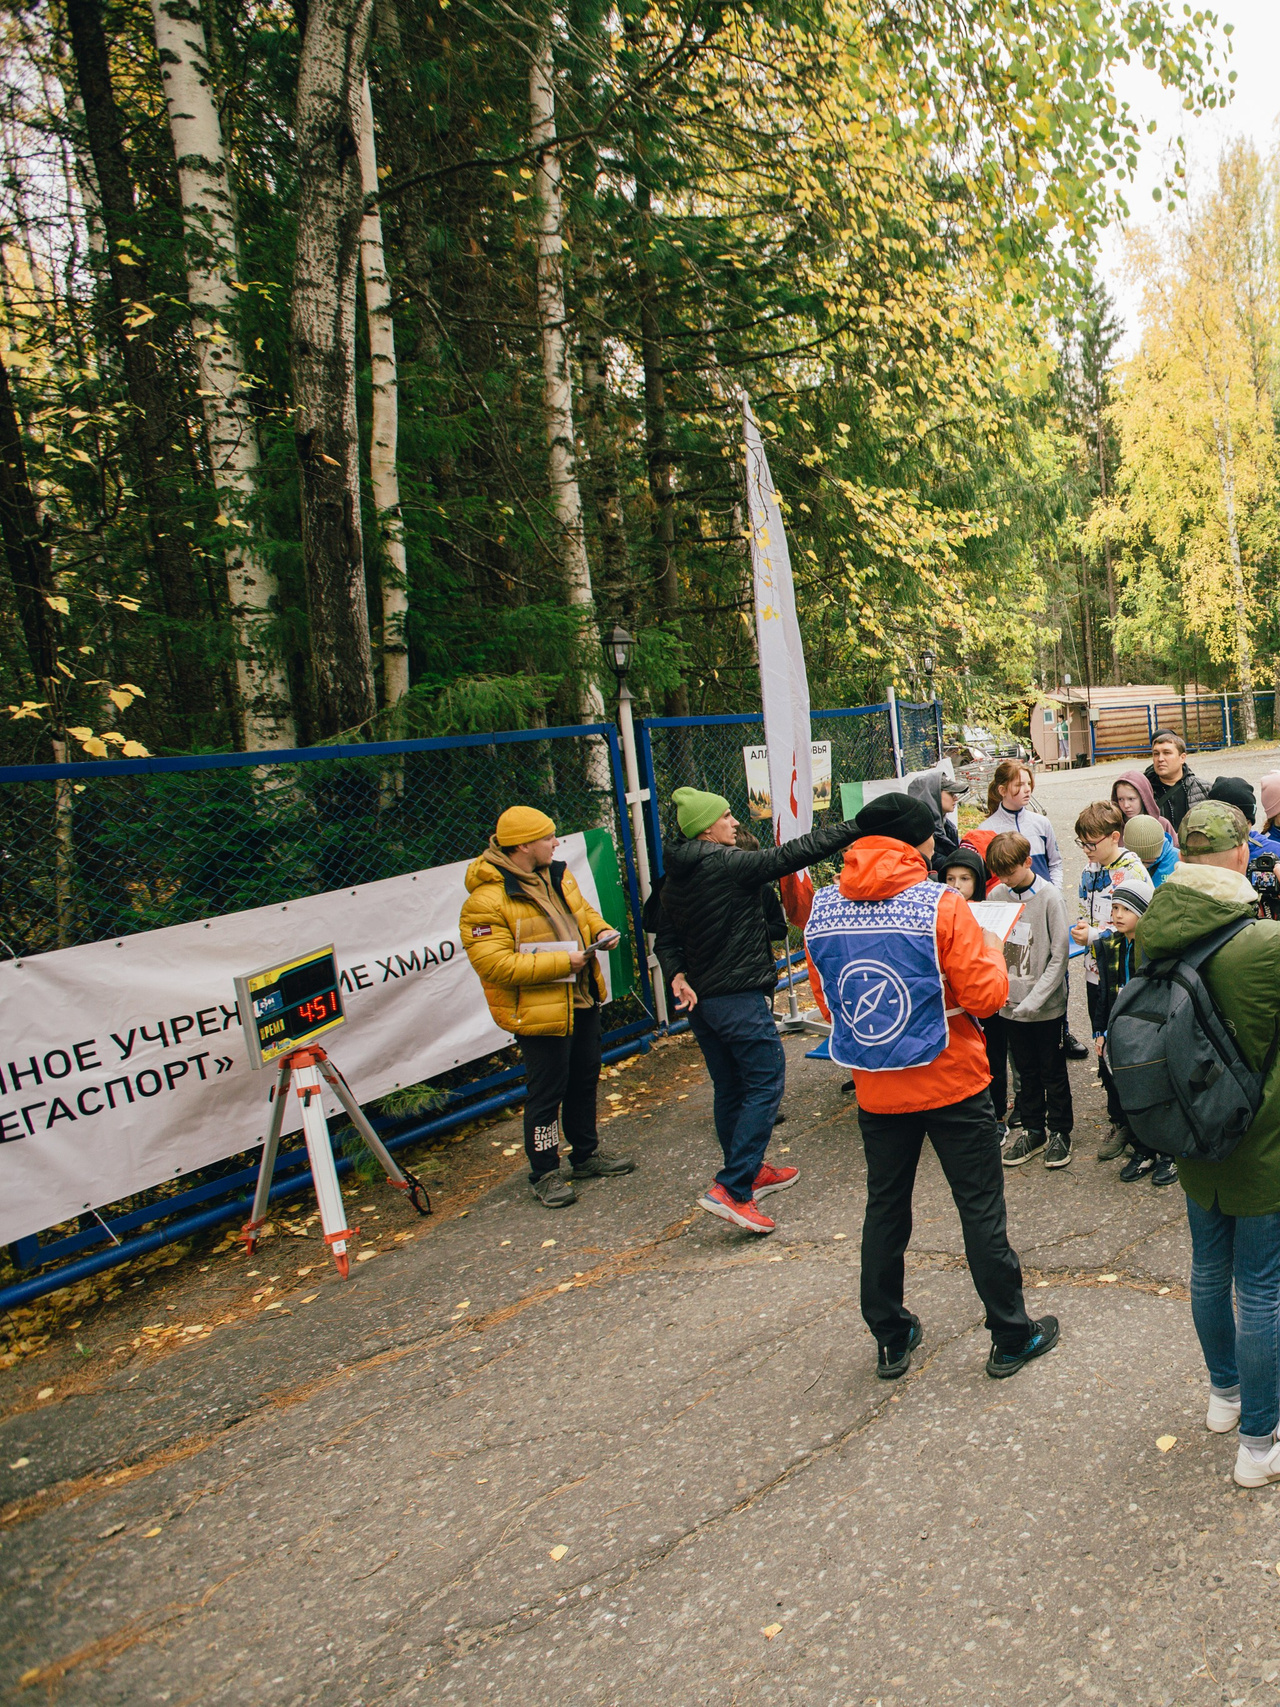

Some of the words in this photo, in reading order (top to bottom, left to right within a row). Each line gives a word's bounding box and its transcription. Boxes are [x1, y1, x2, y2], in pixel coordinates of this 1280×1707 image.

[811, 744, 827, 755] ВЬЯ
[1094, 904, 1101, 913] 21
[298, 991, 337, 1023] 4:51
[0, 1039, 103, 1096] НОЕ
[375, 940, 456, 983] ХМАО
